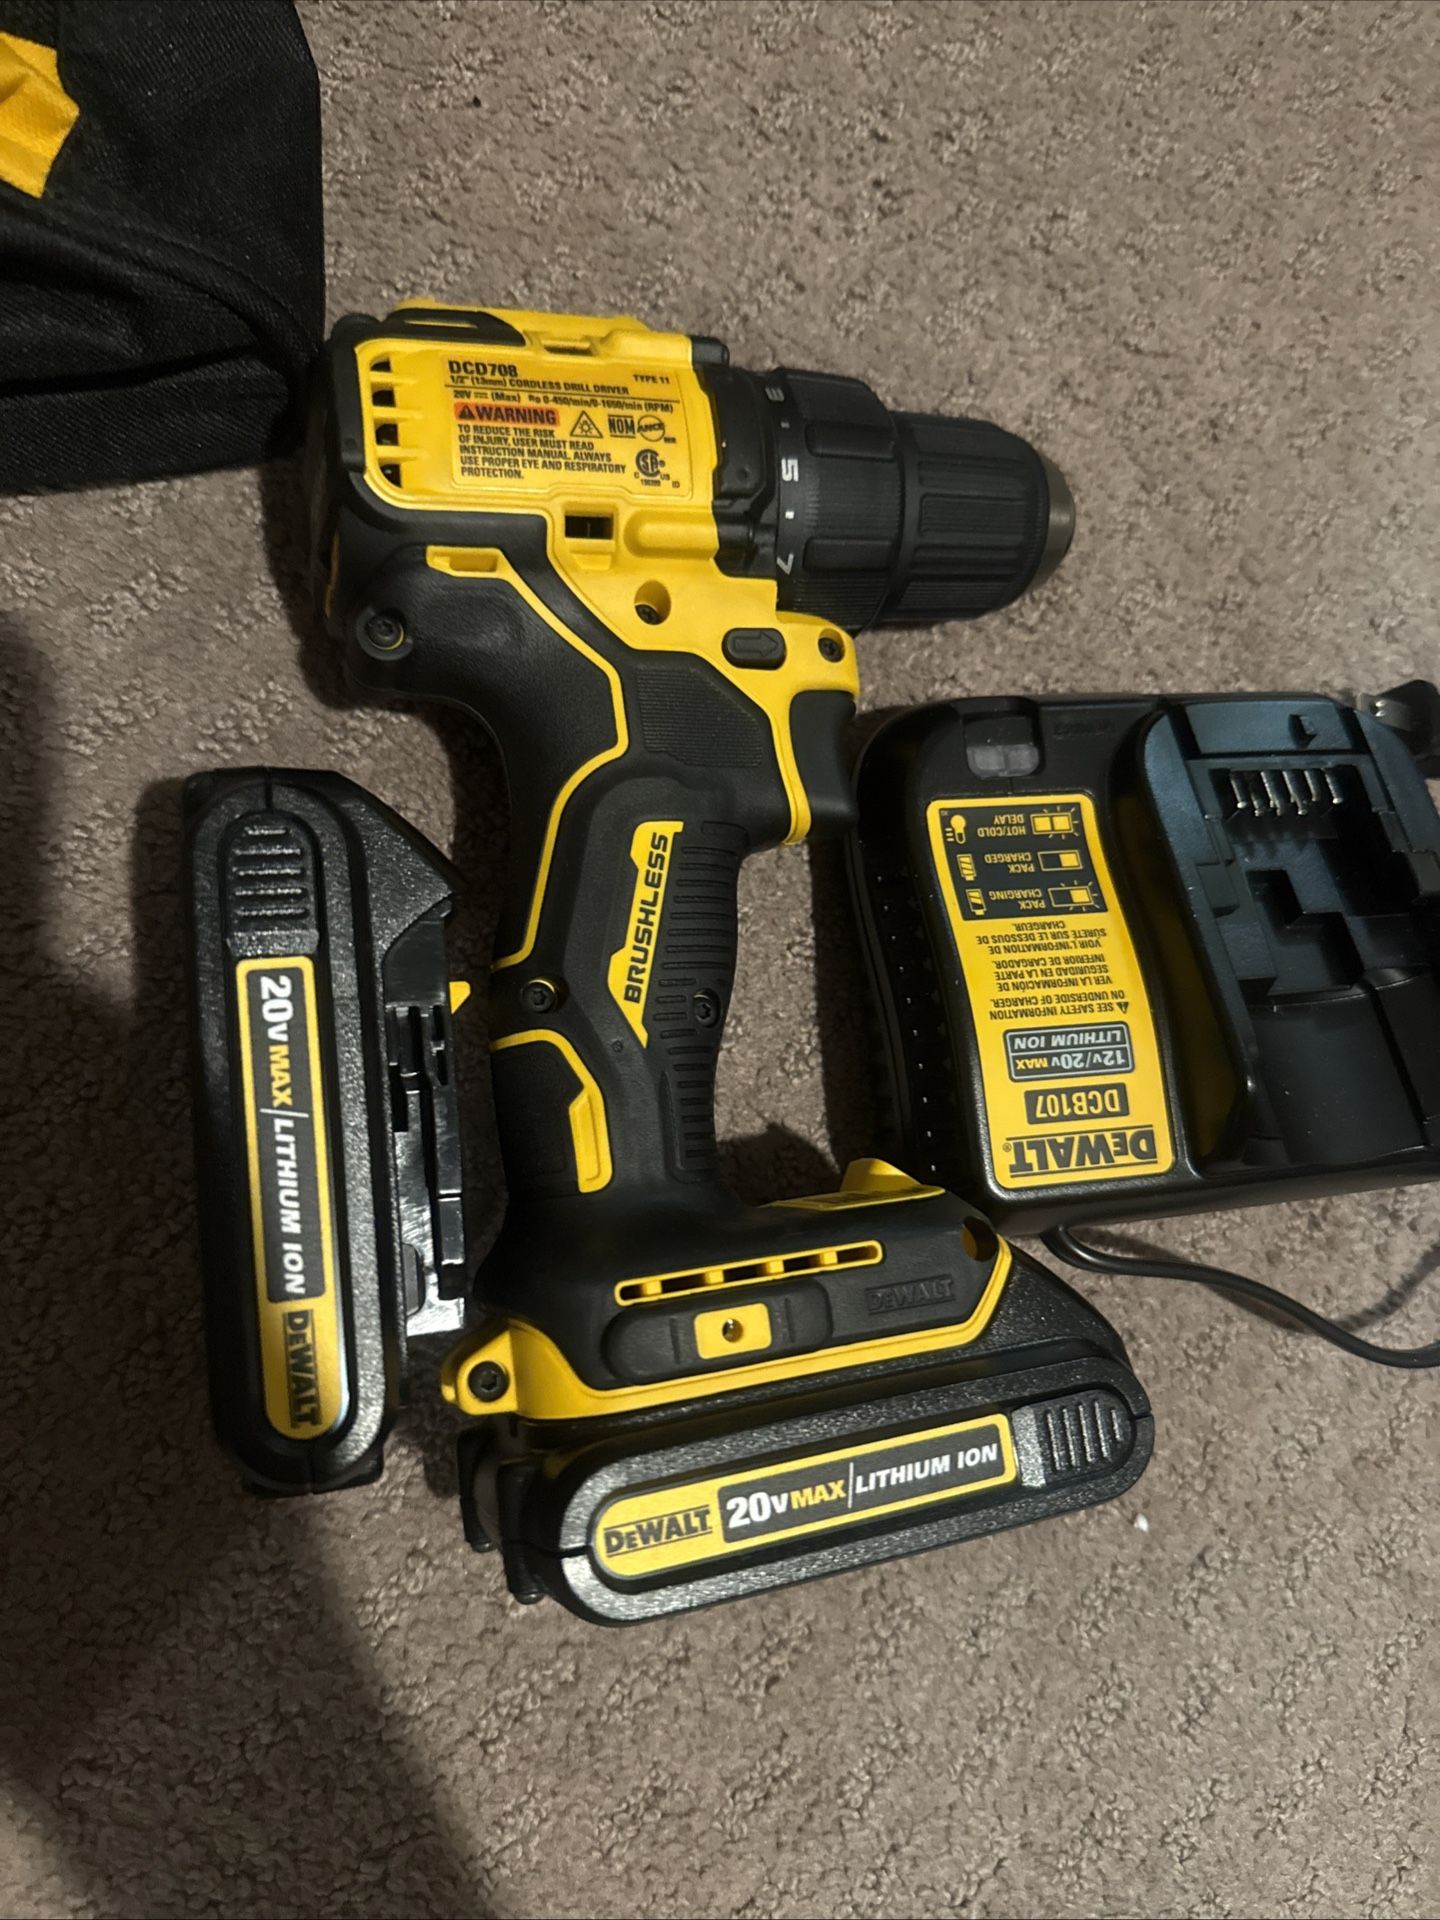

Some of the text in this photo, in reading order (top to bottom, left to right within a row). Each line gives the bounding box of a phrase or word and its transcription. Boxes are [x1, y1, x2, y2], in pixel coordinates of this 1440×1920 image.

[448, 360, 518, 377] DCD708
[509, 378, 562, 390] CORDLESS
[563, 382, 590, 392] DRILL
[593, 384, 629, 395] DRIVER
[633, 374, 657, 384] TYPE
[476, 403, 557, 425] WARNING
[644, 402, 674, 414] (RPM)
[458, 424, 555, 438] TO REDUCE THE RISK
[608, 417, 636, 435] NOM
[459, 435, 471, 443] OF
[512, 438, 538, 448] USER
[540, 439, 566, 449] MUST
[569, 441, 594, 450] READ
[460, 445, 525, 457] INSTRUCTION
[573, 452, 611, 462] ALWAYS
[460, 456, 626, 474] USE PROPER EYE AND RESPIRATORY
[461, 466, 524, 479] PROTECTION.
[781, 458, 799, 482] 5
[776, 553, 794, 575] 7
[994, 814, 1024, 825] DELAY
[977, 826, 1026, 837] HOT/COLD
[984, 852, 1032, 863] CHARGED
[1009, 864, 1035, 873] PACK
[989, 888, 1042, 900] CHARGING
[1019, 900, 1046, 910] PACK
[624, 832, 668, 1004] BRUSHLESS
[976, 935, 990, 945] DE
[991, 932, 1037, 944] DESSOUS
[1039, 932, 1049, 940] LE
[1051, 930, 1070, 940] SUR
[989, 939, 1101, 954] VOIR L'INFORMATION DE
[992, 953, 1105, 969] INFERIOR DE CARGADOR.
[995, 964, 1109, 980] SEGURIDAD EN LA PARTE
[998, 975, 1112, 992] VER LA INFORMACIÓN DE
[991, 990, 1125, 1008] ON UNDERSIDE OF CHARGER.
[989, 1002, 1114, 1020] SEE SAFETY INFORMATION
[1014, 1030, 1121, 1049] LITHIUM ION
[1016, 1057, 1048, 1069] MAX
[1036, 1089, 1120, 1118] DCB107
[273, 1118, 302, 1234] LITHIUM
[282, 1243, 306, 1294] ION
[855, 1456, 950, 1494] LITHIUM
[957, 1443, 998, 1470] ION
